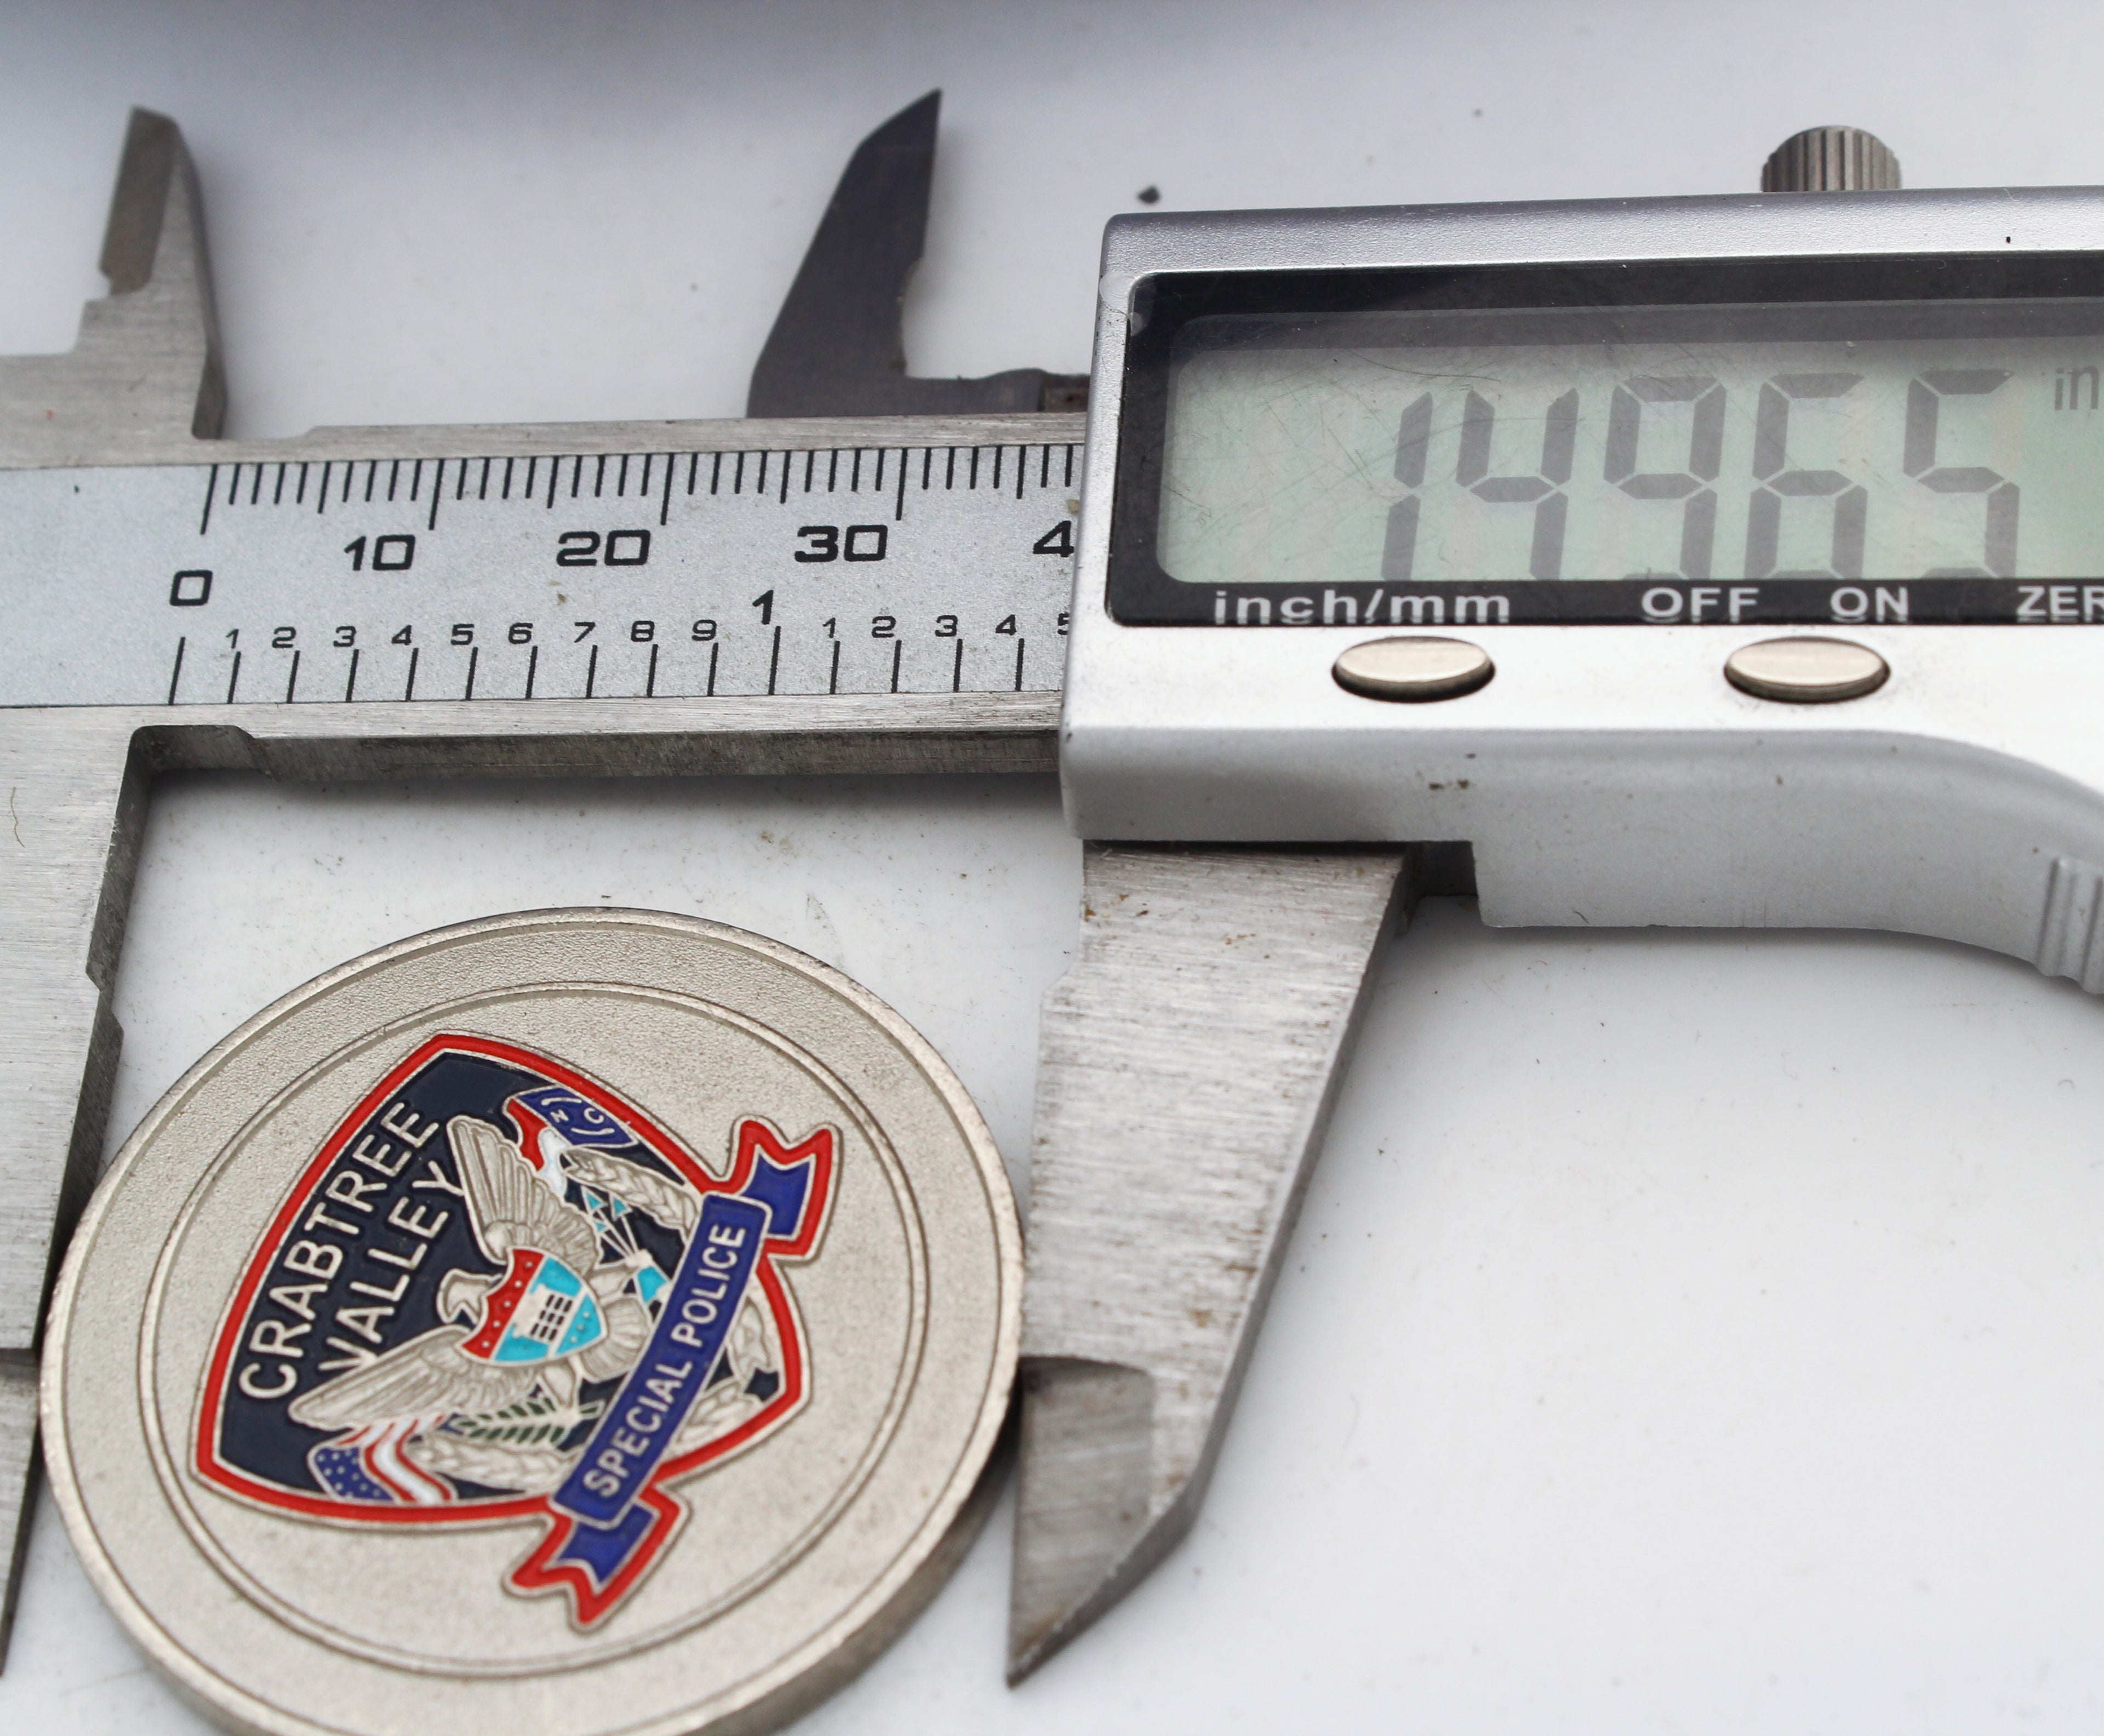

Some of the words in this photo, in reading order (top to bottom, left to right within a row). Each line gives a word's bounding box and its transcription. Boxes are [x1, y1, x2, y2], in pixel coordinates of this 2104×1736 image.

[2055, 366, 2100, 411] in
[169, 570, 213, 606] 0
[344, 535, 416, 571] 10
[556, 529, 651, 567] 20
[794, 524, 888, 563] 30
[1032, 520, 1075, 558] 4
[1214, 589, 1511, 624] inch/mm
[1641, 586, 1760, 622] OFF
[1829, 586, 1909, 621] ON
[2016, 585, 2104, 621] ZER
[226, 629, 239, 649] 1
[272, 626, 296, 648] 2
[333, 626, 357, 647] 3
[391, 625, 413, 646] 4
[450, 623, 474, 646] 5
[508, 622, 533, 645] 6
[574, 621, 596, 643] 7
[630, 620, 655, 642] 8
[691, 619, 717, 642] 9
[752, 590, 774, 625] 1
[822, 617, 836, 638] 1
[871, 615, 896, 638] 2
[935, 615, 958, 637] 3
[995, 614, 1017, 636] 4
[238, 1101, 439, 1399] CRABTREE
[317, 1160, 465, 1371] VALLEY
[582, 1361, 693, 1497] SPECIAL
[670, 1224, 746, 1348] POLICE
